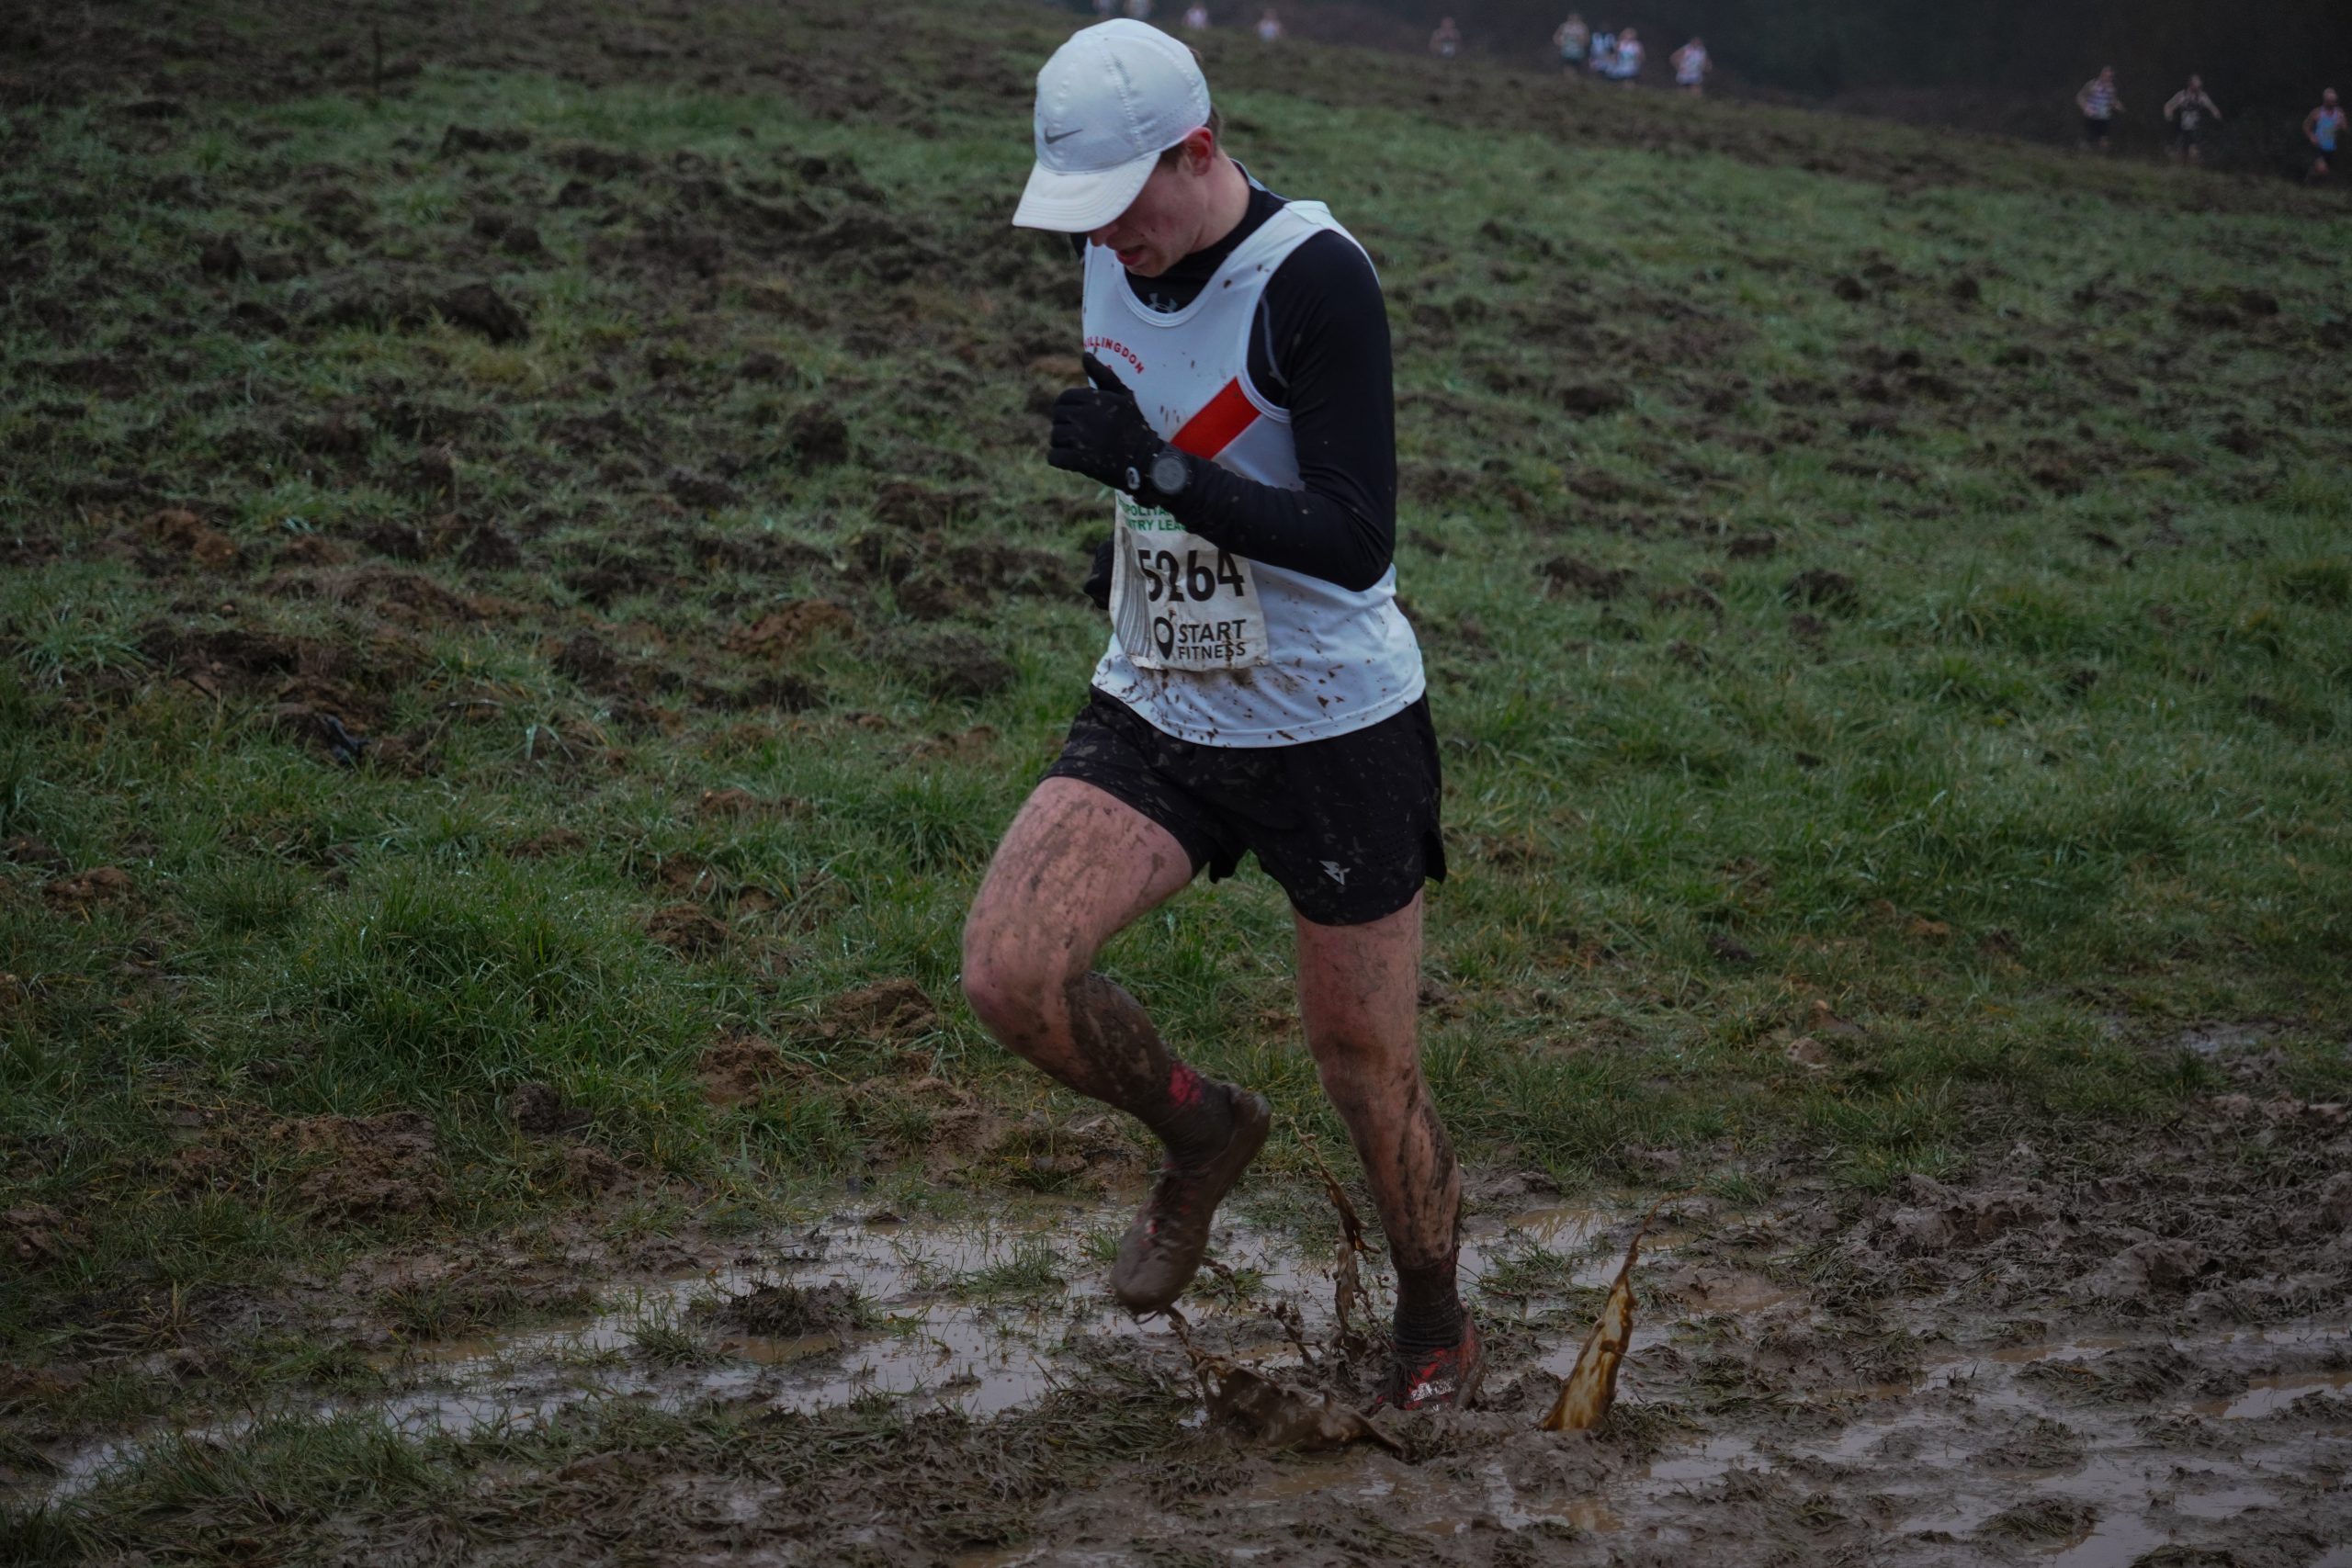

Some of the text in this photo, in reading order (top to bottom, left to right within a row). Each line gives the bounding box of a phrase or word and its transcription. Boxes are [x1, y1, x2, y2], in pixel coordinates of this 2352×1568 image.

[1137, 549, 1245, 602] 5264
[1178, 619, 1247, 643] START
[1178, 642, 1246, 660] FITNESS
